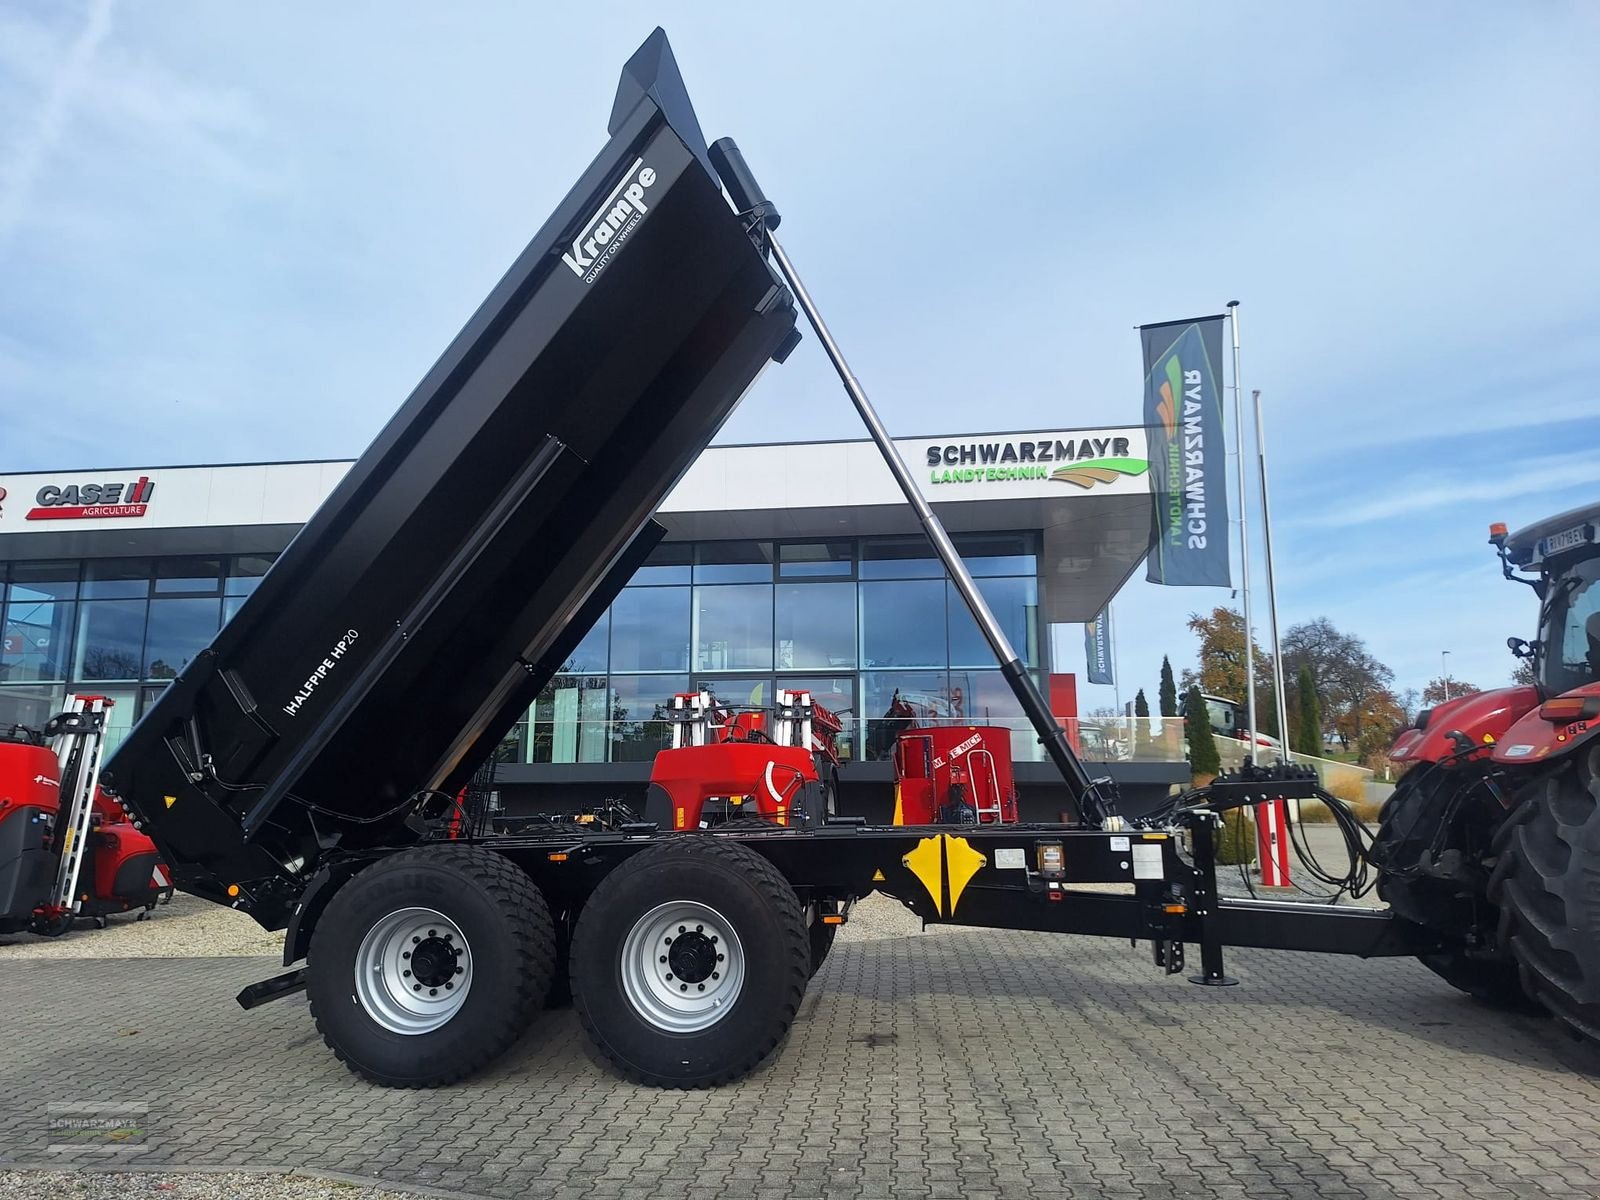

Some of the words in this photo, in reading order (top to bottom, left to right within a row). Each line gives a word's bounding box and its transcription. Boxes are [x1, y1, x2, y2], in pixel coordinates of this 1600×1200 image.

[561, 157, 657, 278] Krampe
[585, 254, 611, 284] QUALITY
[608, 241, 621, 254] ON
[618, 213, 642, 242] WHEELS
[926, 437, 1130, 467] SCHWARZMAYR
[930, 466, 1049, 485] LANDTECHNIK
[36, 483, 124, 506] CASE
[82, 505, 142, 516] AGRICULTURE
[330, 629, 359, 659] HP20
